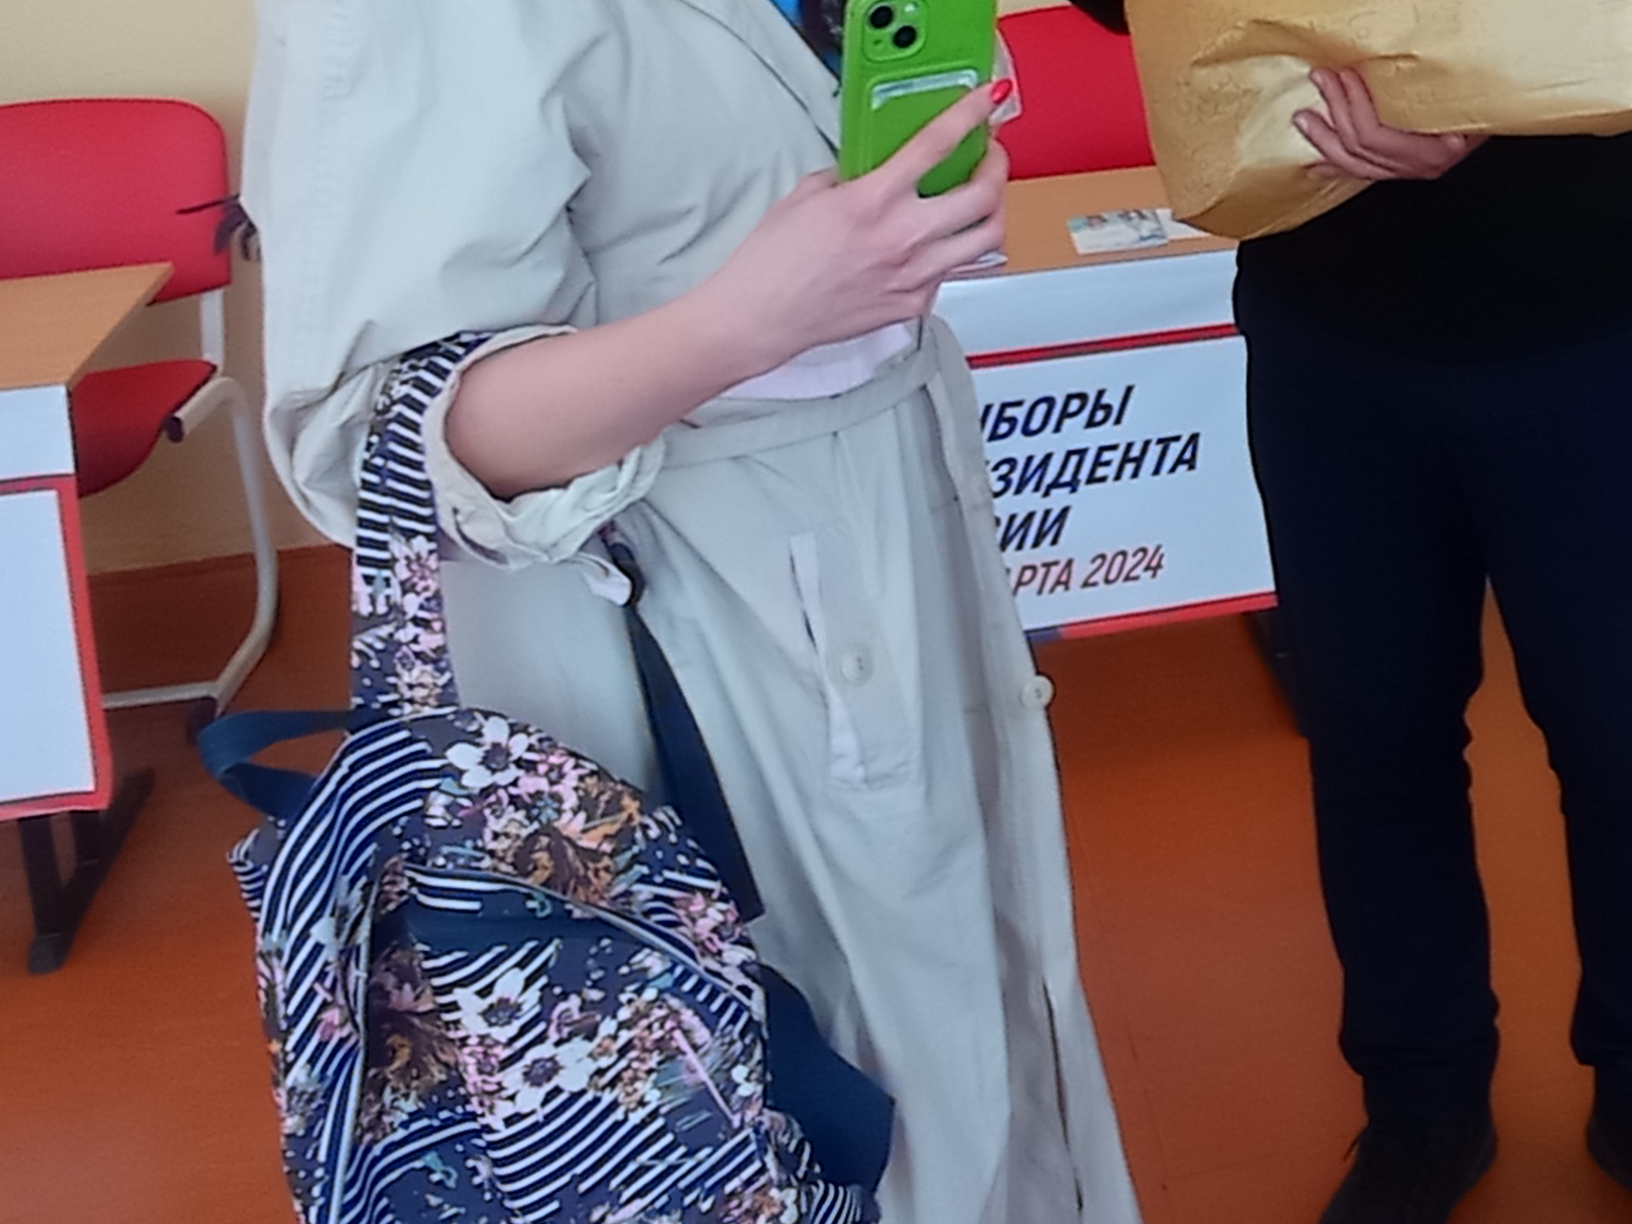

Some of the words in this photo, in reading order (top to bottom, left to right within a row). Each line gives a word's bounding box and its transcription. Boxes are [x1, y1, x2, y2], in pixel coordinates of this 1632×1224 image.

[985, 432, 1202, 499] ЗИДЕНТА
[1005, 557, 1075, 597] РТА
[1080, 543, 1166, 590] 2024
